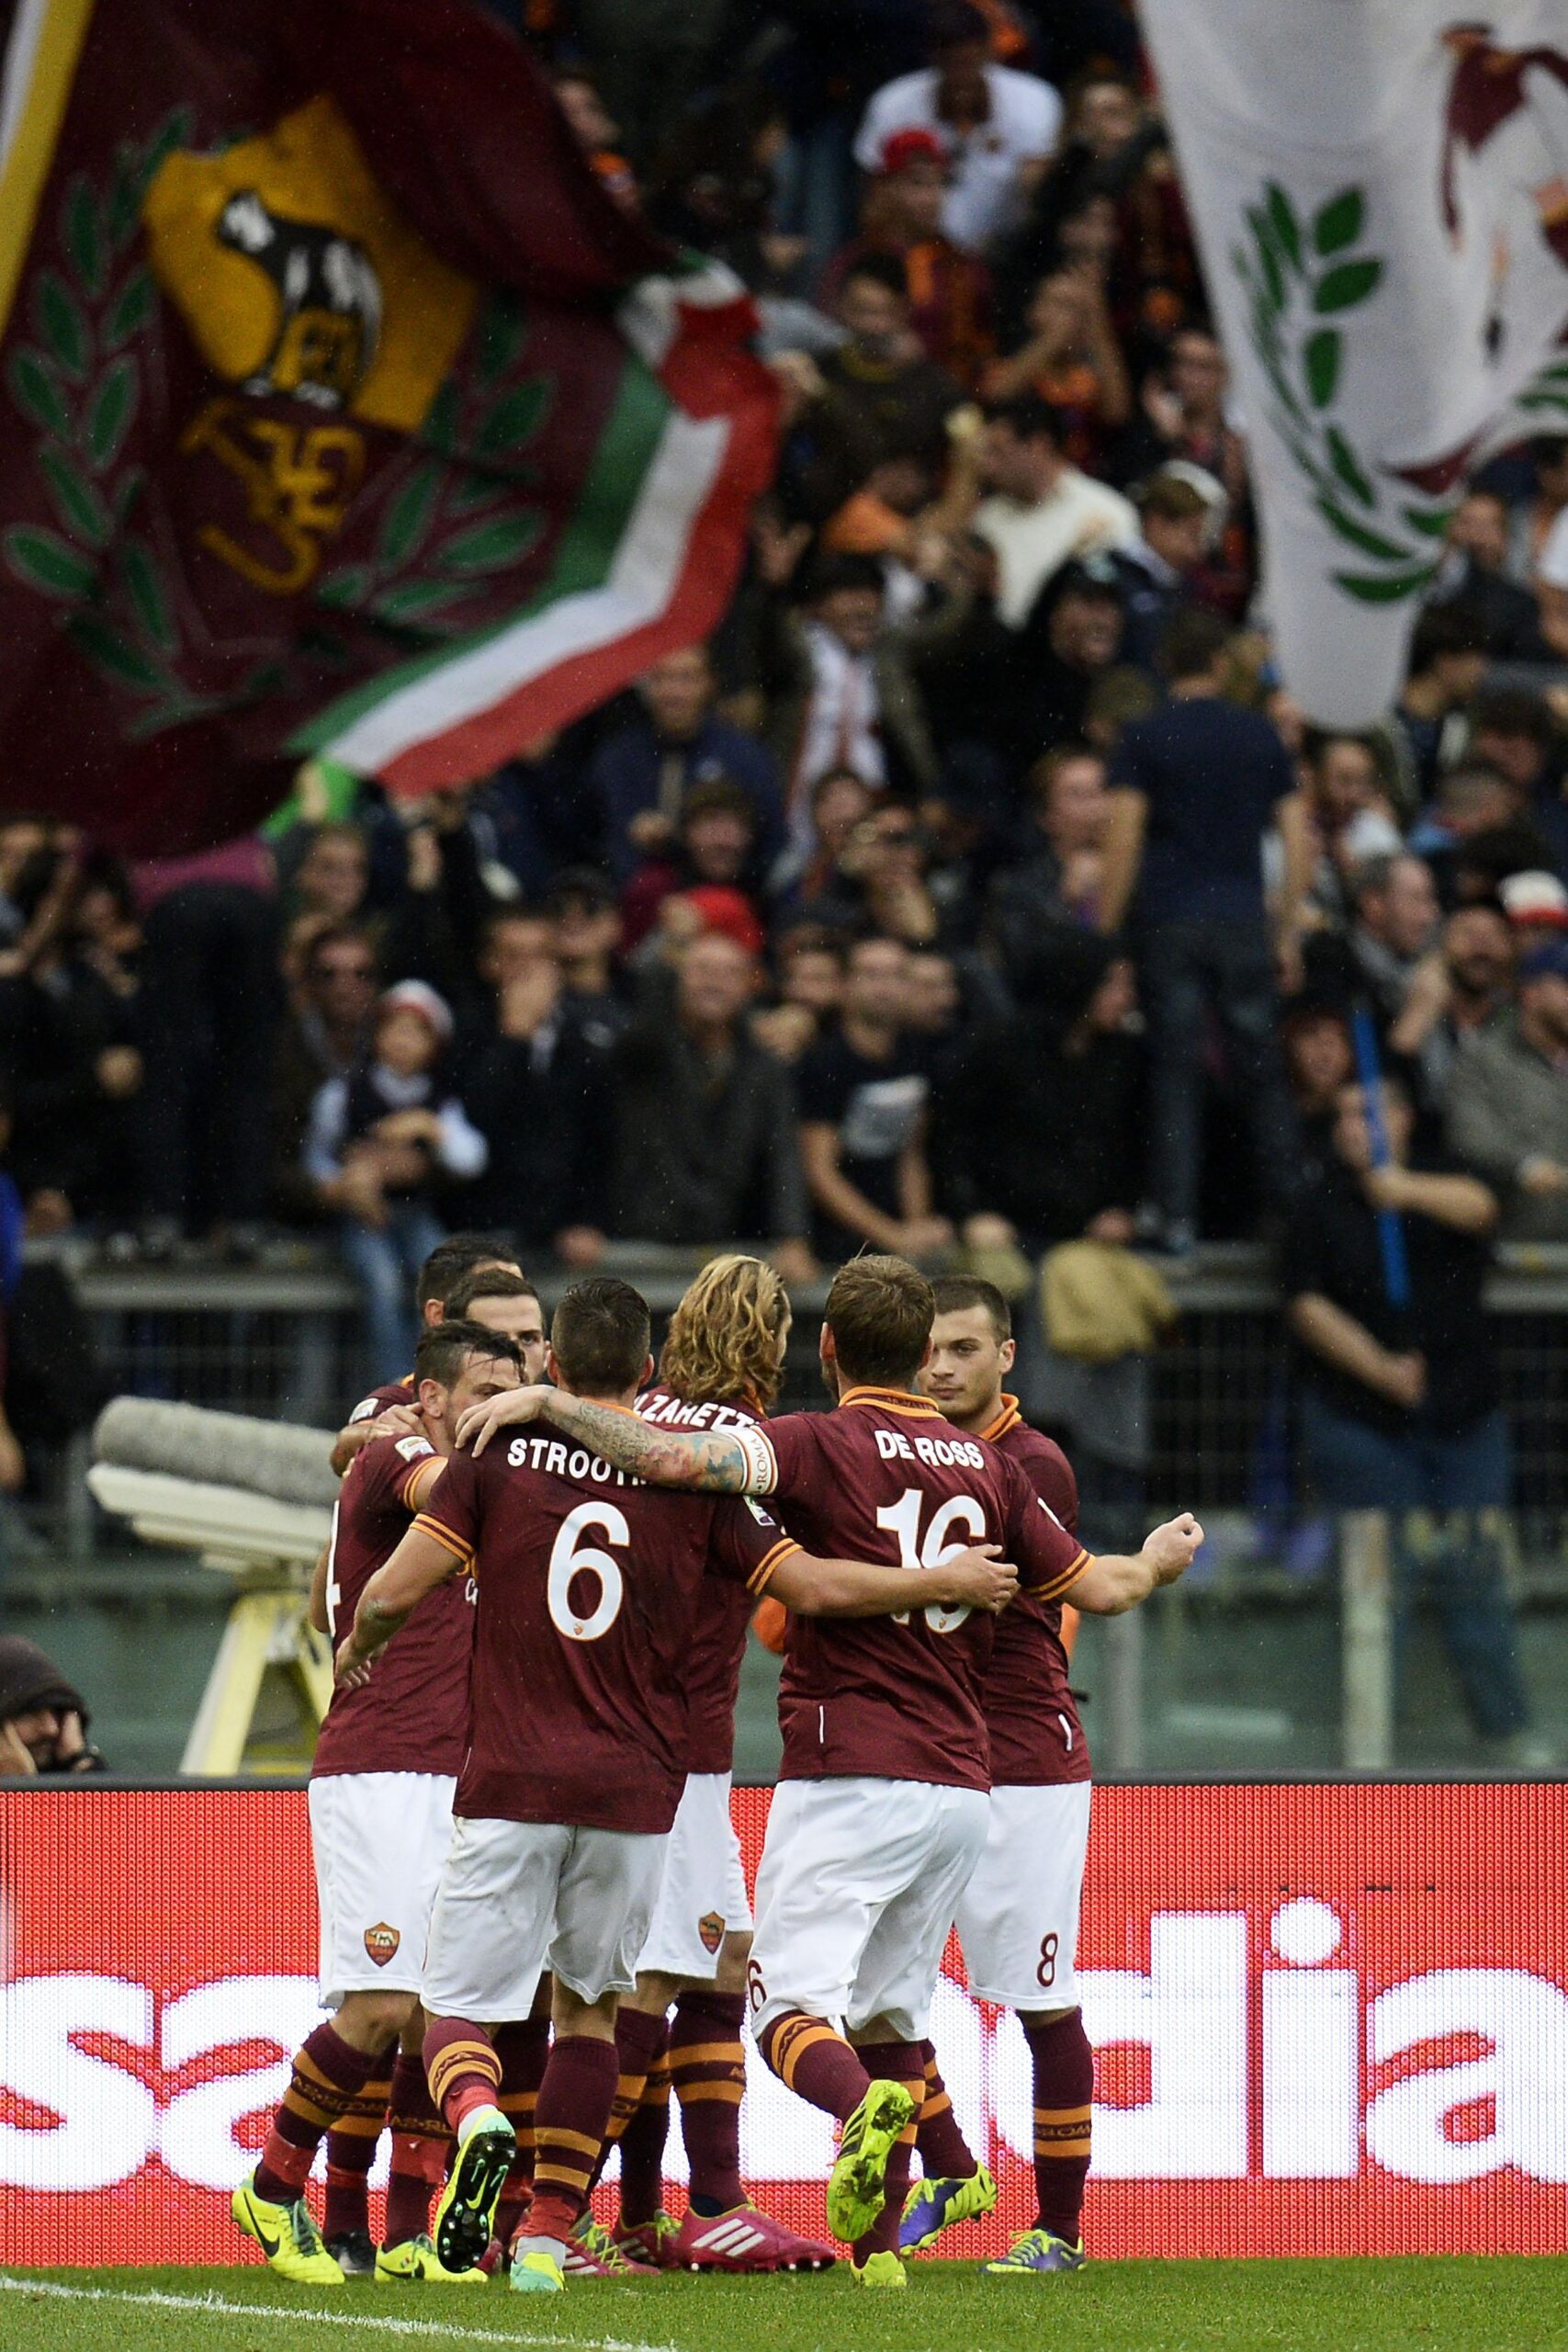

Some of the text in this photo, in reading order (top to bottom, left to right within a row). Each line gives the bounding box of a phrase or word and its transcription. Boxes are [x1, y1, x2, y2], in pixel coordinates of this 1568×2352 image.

[874, 1430, 916, 1460] DE
[547, 1501, 630, 1641] 6
[1036, 1932, 1058, 1987] 8
